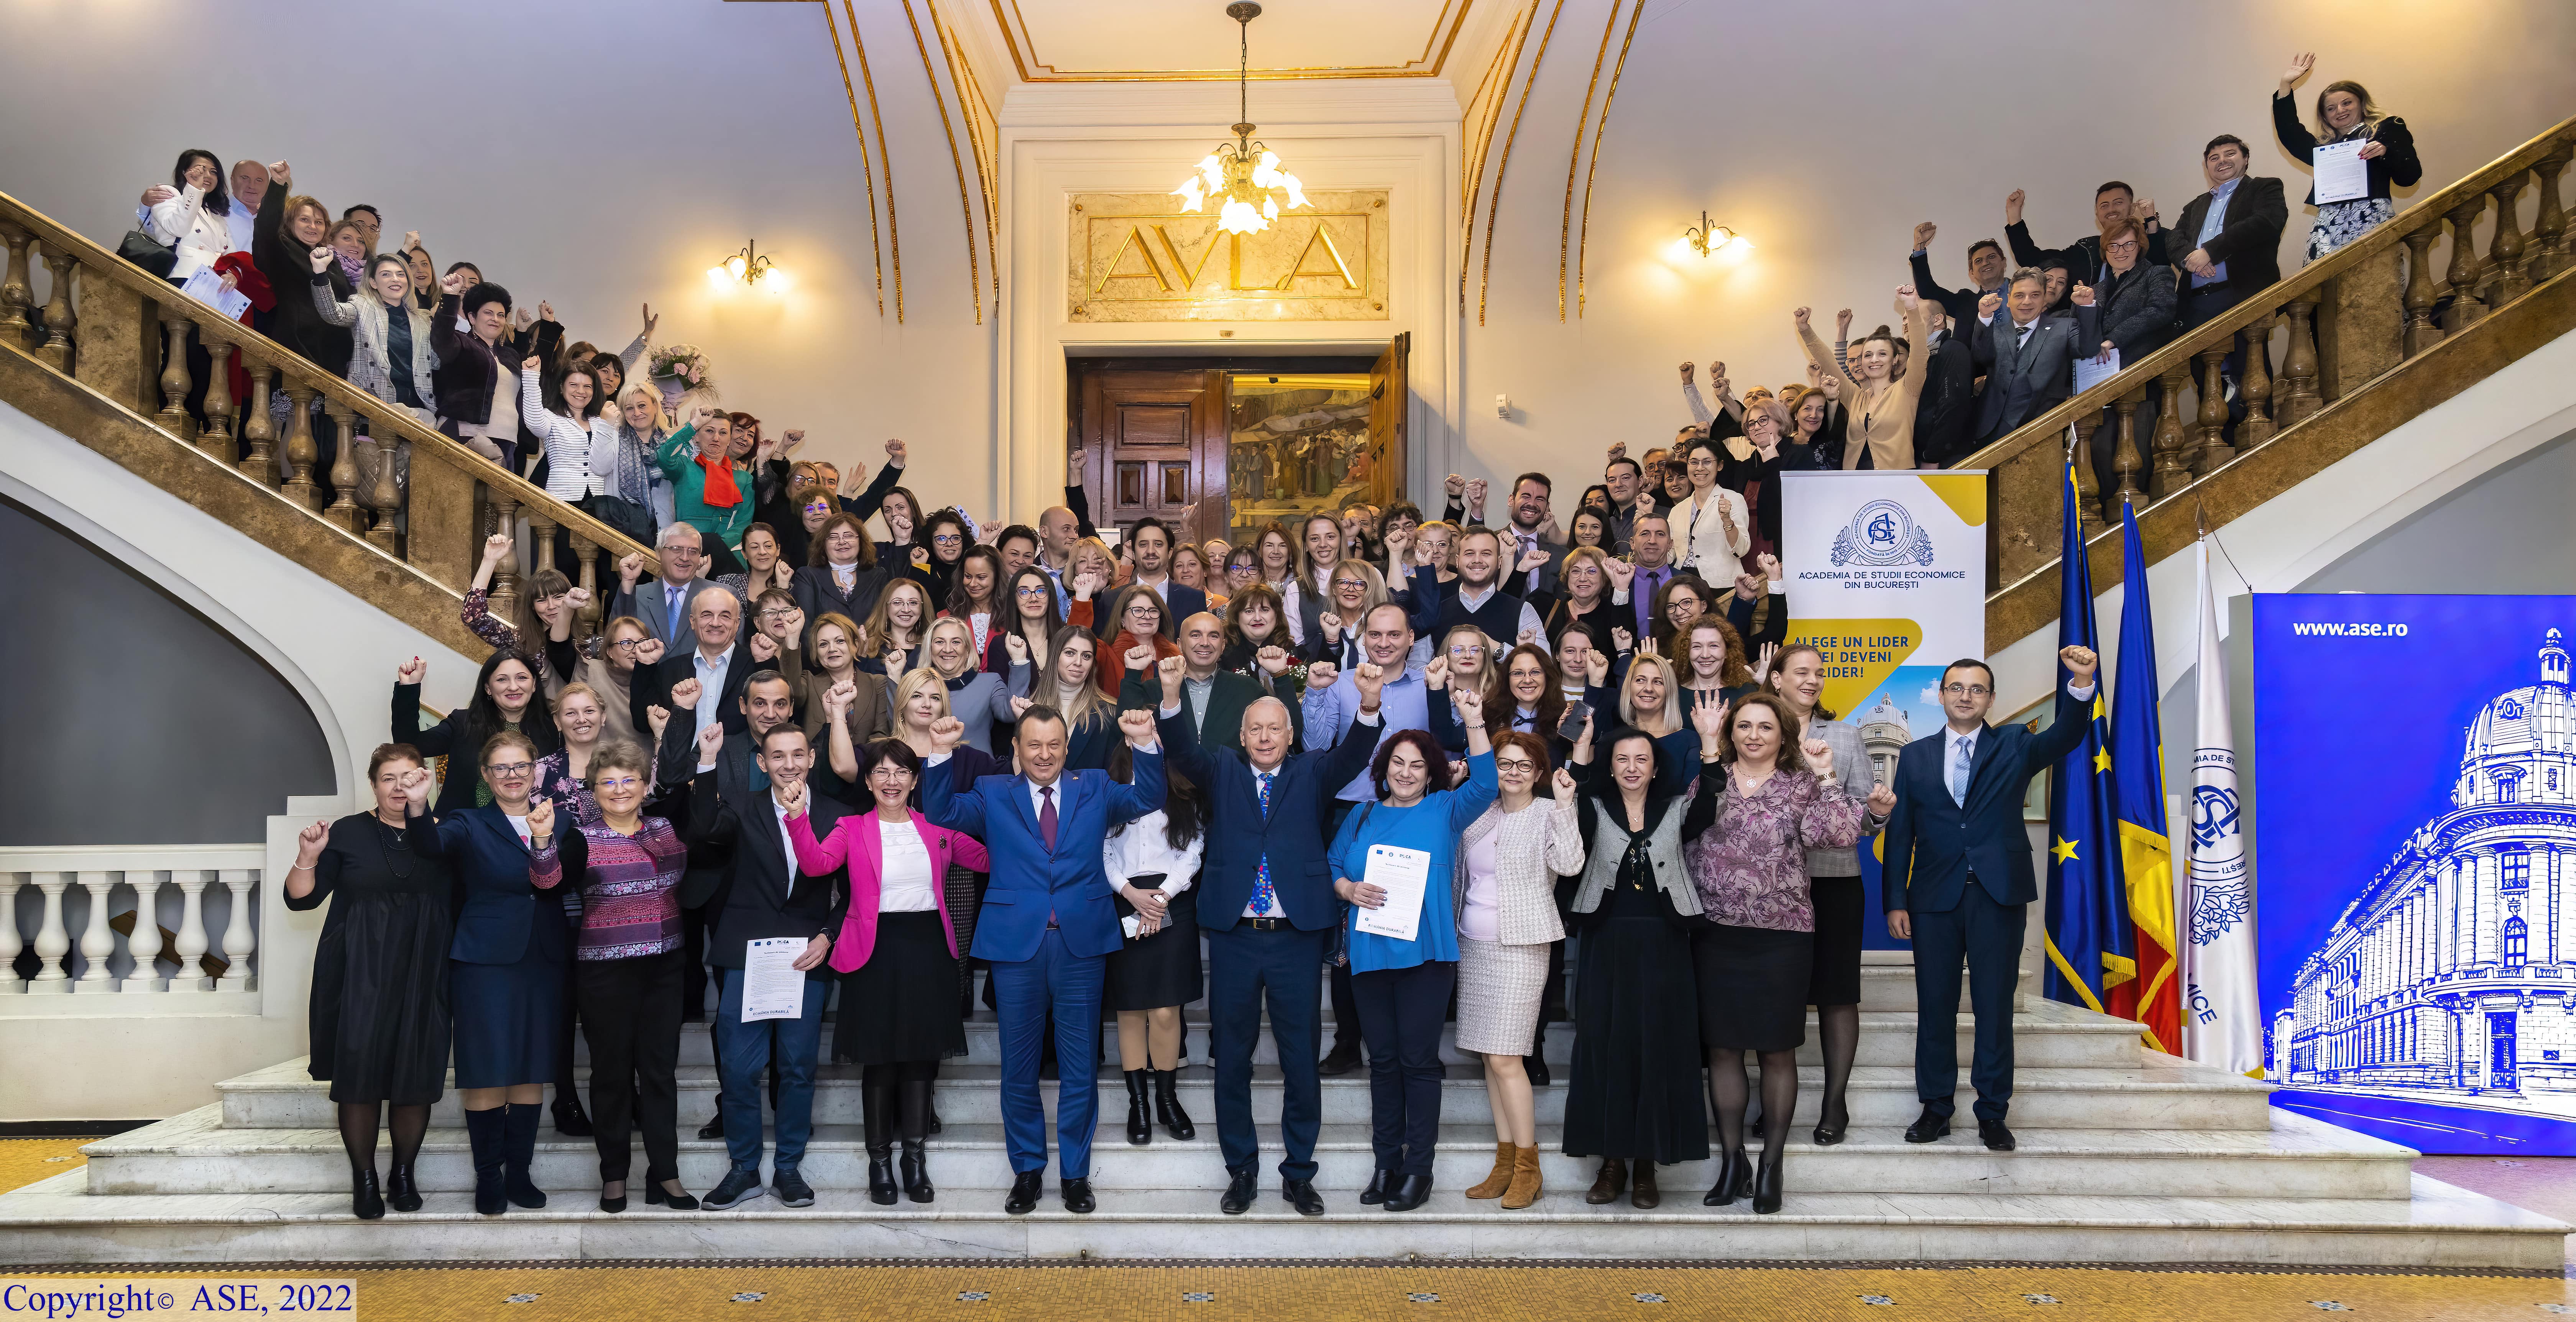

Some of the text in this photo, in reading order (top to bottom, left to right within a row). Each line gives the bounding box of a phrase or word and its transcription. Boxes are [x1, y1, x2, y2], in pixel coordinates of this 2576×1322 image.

[1095, 223, 1360, 292] AVLA
[1865, 581, 1919, 590] BUCUREȘTI
[2293, 622, 2408, 637] www.ase.ro
[1843, 637, 1862, 647] UN
[1869, 636, 1908, 647] LIDER
[1821, 652, 1891, 662] EI DEVENI
[1823, 667, 1863, 678] IDER!
[2226, 757, 2234, 765] ST
